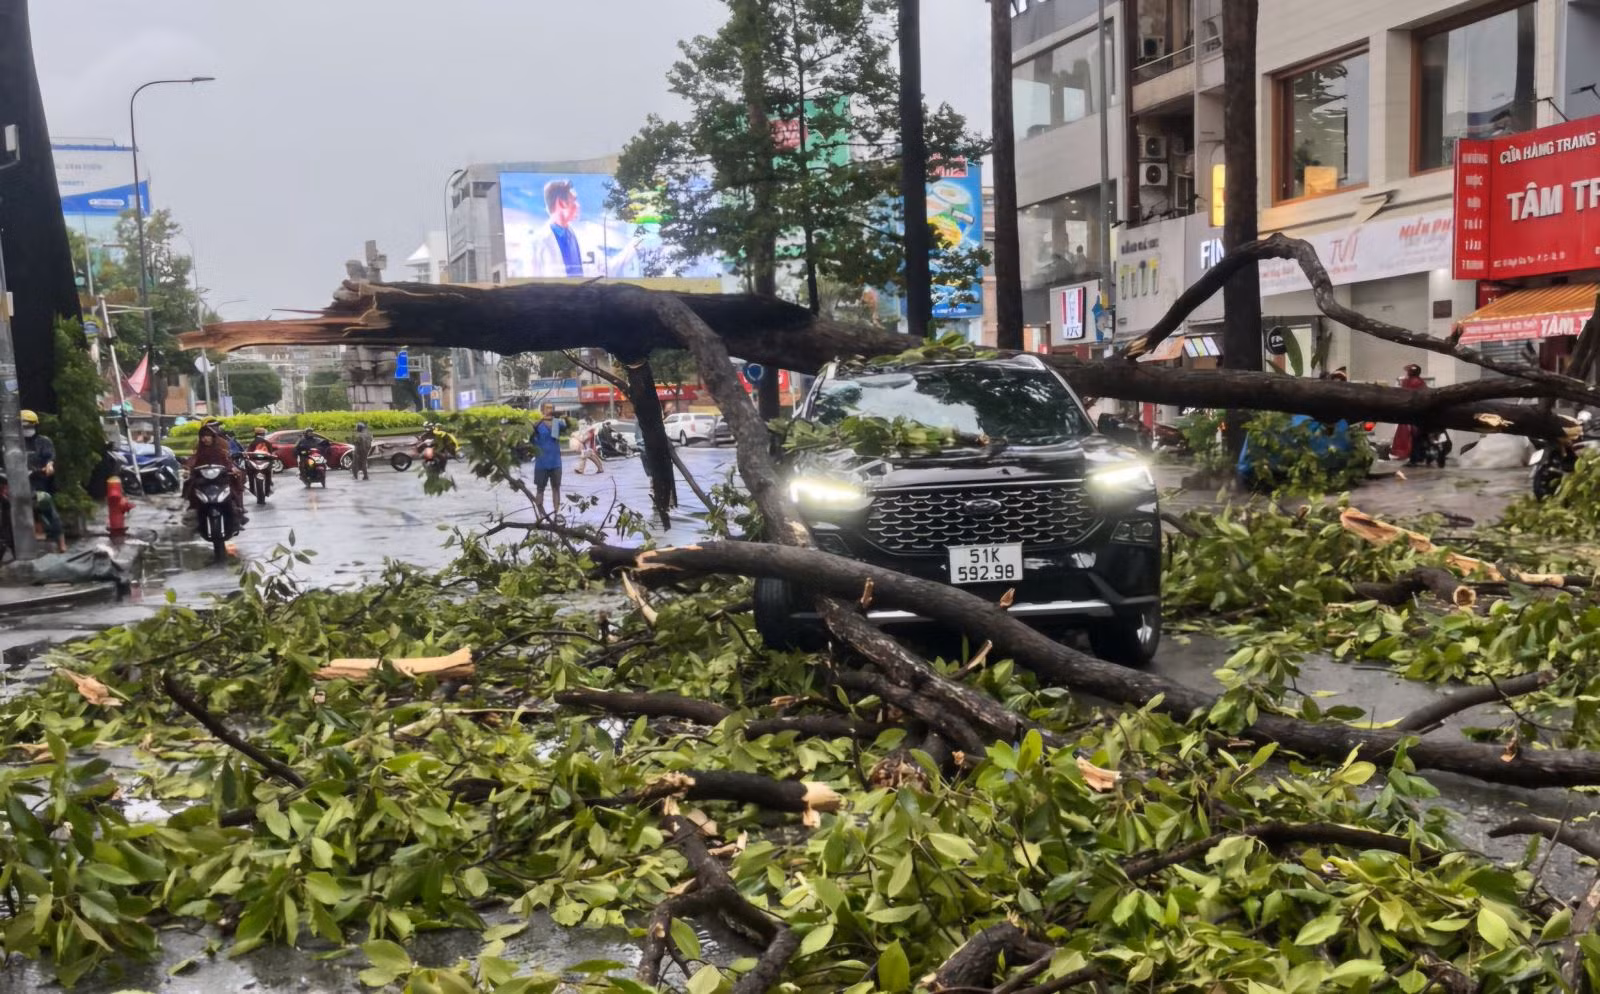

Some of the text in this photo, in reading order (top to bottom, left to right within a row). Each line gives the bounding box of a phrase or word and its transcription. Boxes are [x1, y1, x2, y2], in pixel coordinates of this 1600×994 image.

[1523, 142, 1554, 160] HÀNG
[1556, 132, 1596, 153] TRANG
[1506, 182, 1564, 221] TÂM
[970, 548, 1000, 563] 51K
[958, 564, 1014, 581] 592.98
